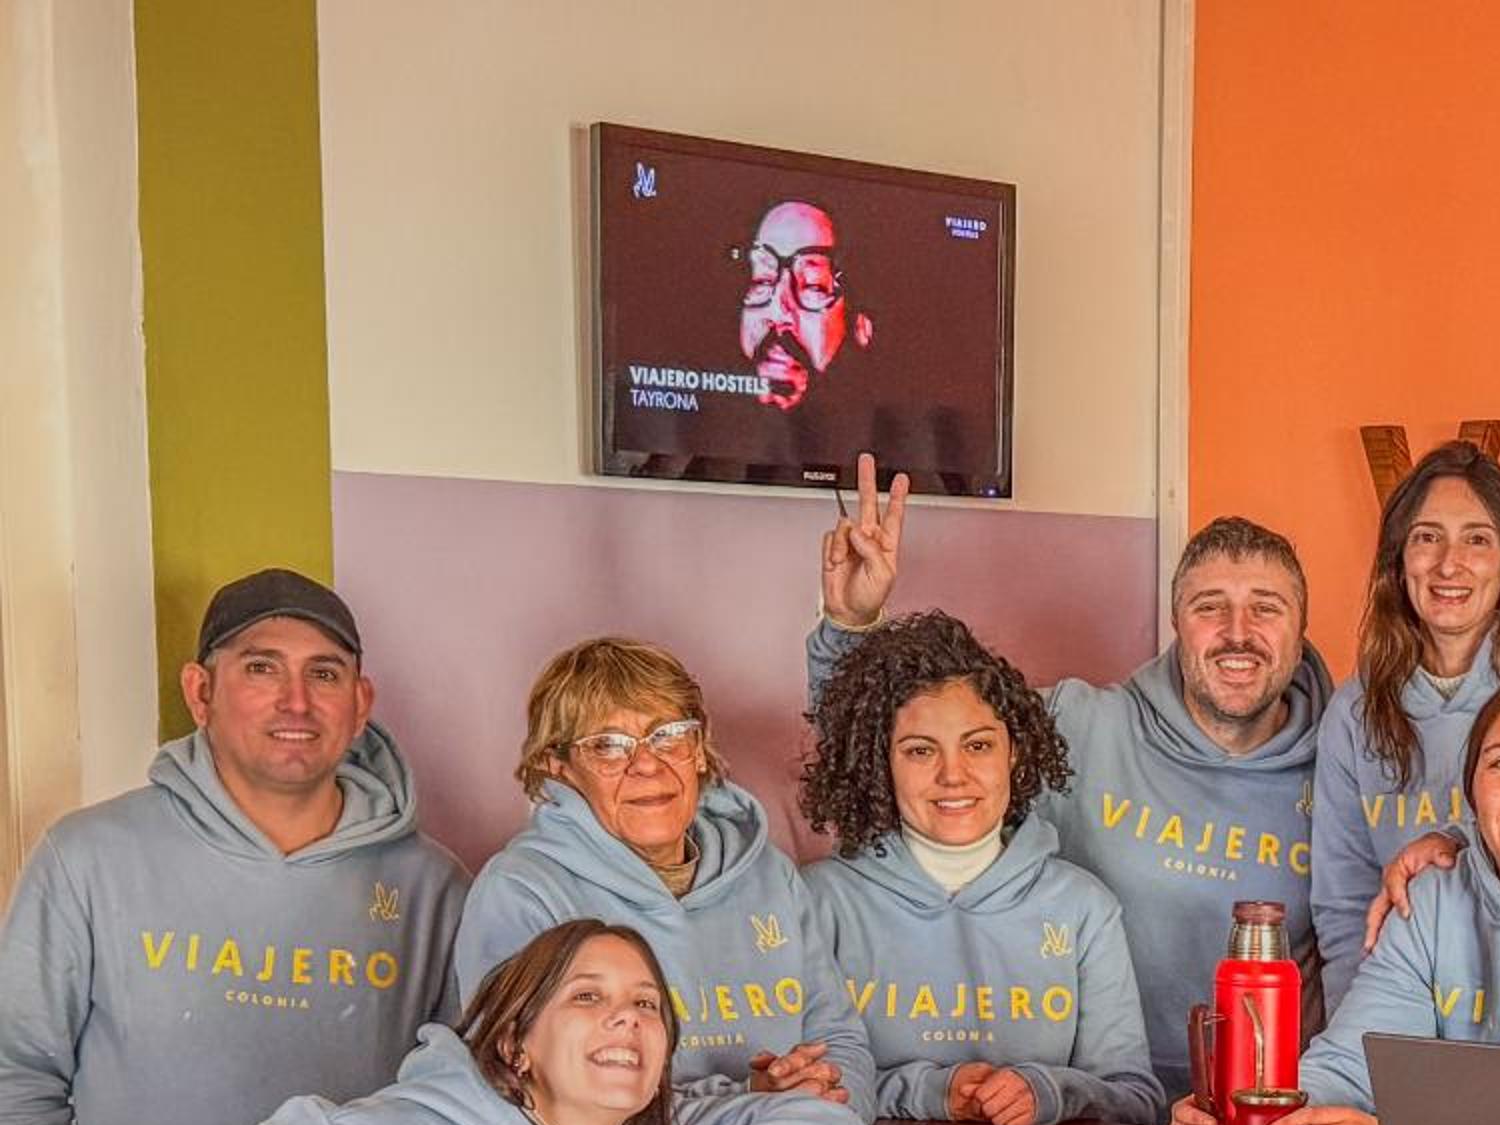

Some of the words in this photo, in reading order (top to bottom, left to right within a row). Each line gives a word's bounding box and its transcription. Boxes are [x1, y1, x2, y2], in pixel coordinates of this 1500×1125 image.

[629, 365, 699, 389] VIAJERO
[701, 371, 770, 395] HOSTELS
[630, 388, 699, 412] TAYRONA
[142, 931, 398, 989] VIAJERO
[225, 990, 310, 1009] COLONIA
[846, 977, 1073, 1021] VIAJERO
